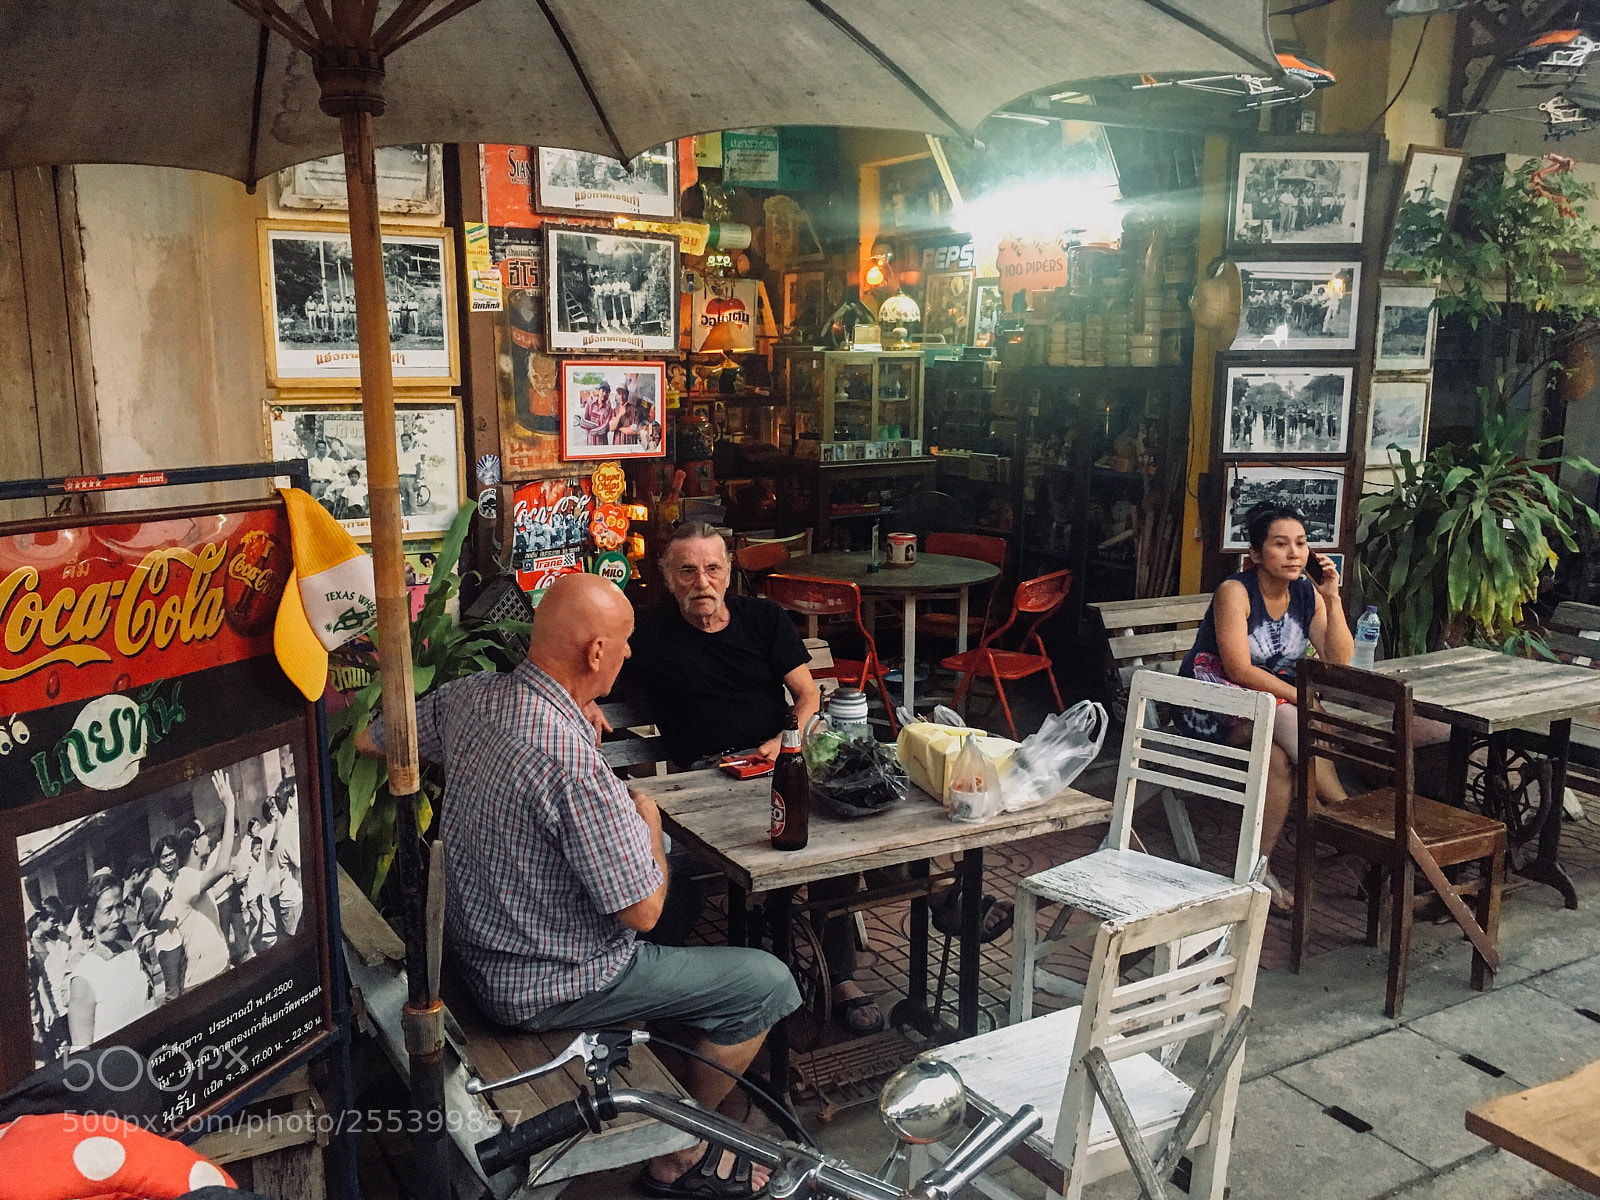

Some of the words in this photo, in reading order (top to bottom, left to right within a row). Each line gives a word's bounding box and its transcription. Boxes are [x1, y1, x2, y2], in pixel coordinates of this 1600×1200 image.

[922, 243, 976, 270] PEPS
[1005, 263, 1023, 277] 100
[1026, 257, 1064, 275] PIPERS
[597, 472, 620, 482] Chupa
[596, 481, 620, 491] Chups
[534, 556, 564, 570] Trane
[601, 568, 625, 579] MILO
[324, 591, 356, 602] TEXAS
[208, 999, 254, 1035] ประมาณปี
[251, 1046, 273, 1067] 17.00
[274, 1042, 283, 1052] น.
[292, 1020, 314, 1041] 22.30
[314, 1015, 323, 1026] น.
[178, 1053, 210, 1078] บริเวณ
